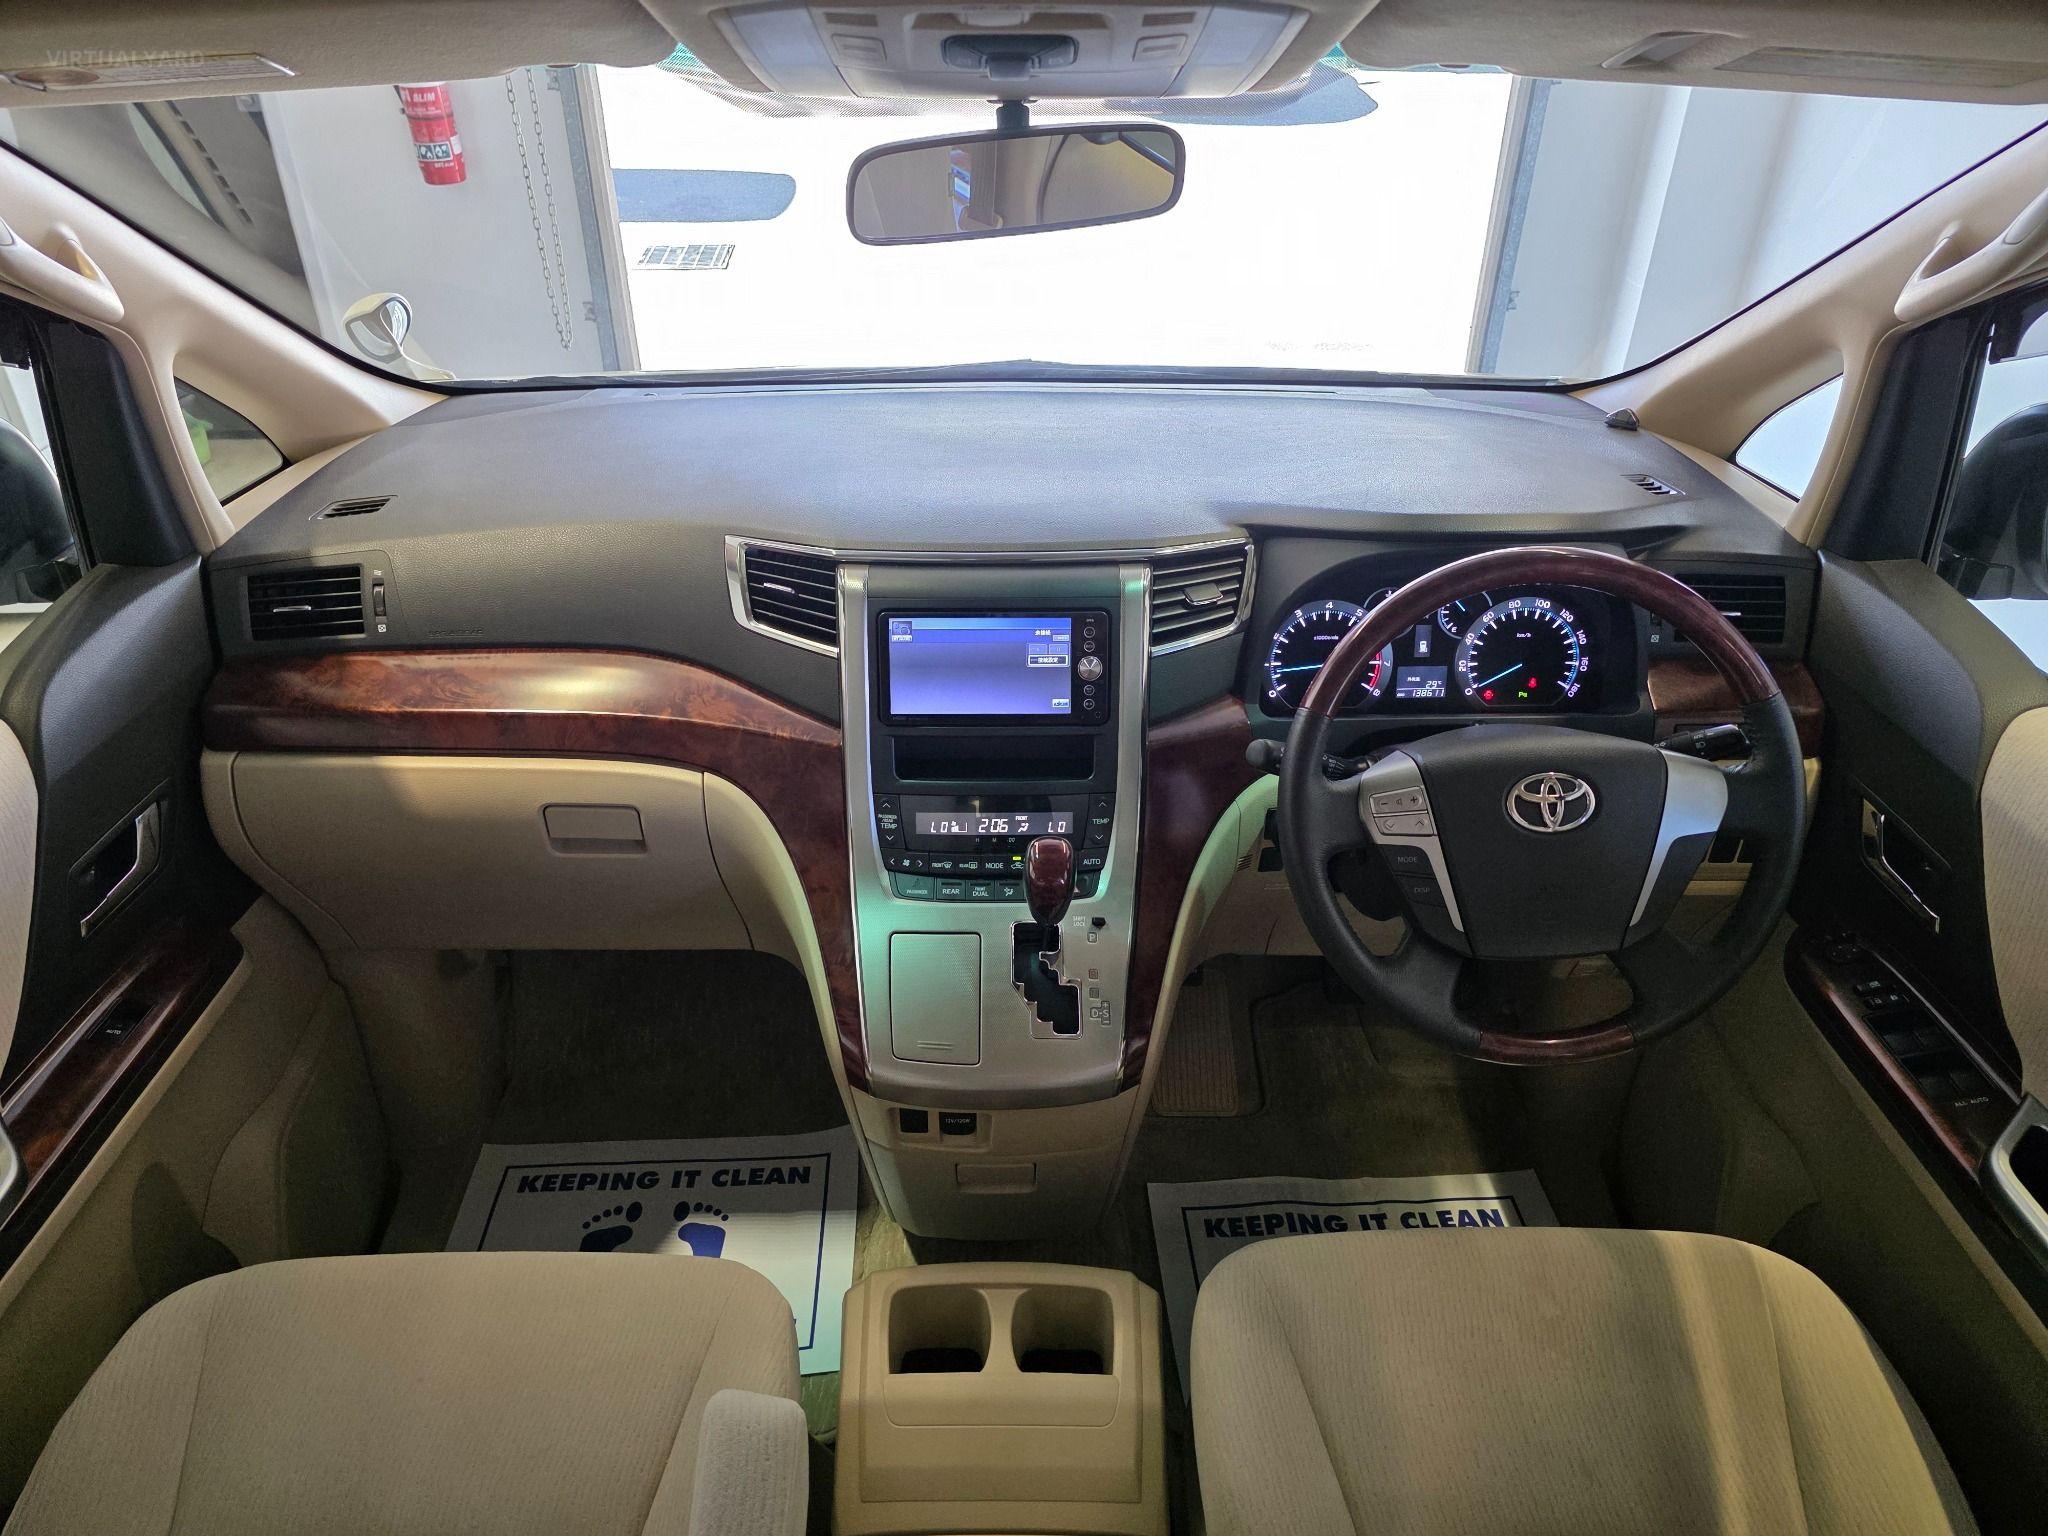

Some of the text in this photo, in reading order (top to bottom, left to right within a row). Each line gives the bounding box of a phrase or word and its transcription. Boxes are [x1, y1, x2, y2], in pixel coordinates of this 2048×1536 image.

[1325, 601, 1334, 609] 4
[1508, 599, 1521, 609] 80
[1534, 598, 1551, 609] 100
[1294, 609, 1303, 617] 3
[1355, 608, 1364, 617] 5
[1482, 611, 1495, 623] 60
[1560, 608, 1574, 622] 120
[1465, 632, 1475, 646] 40
[1576, 629, 1587, 645] 140
[1458, 659, 1467, 672] 20
[1580, 656, 1589, 672] 160
[1268, 690, 1277, 698] 0
[1464, 687, 1473, 696] 0
[1567, 682, 1581, 698] 180
[880, 822, 898, 830] TEMP
[1083, 858, 1101, 866] AUTO
[942, 888, 960, 896] REAR
[517, 1166, 811, 1193] KEEPING IT CLEAN
[1203, 1208, 1505, 1238] KEEPING IT CLEAN
